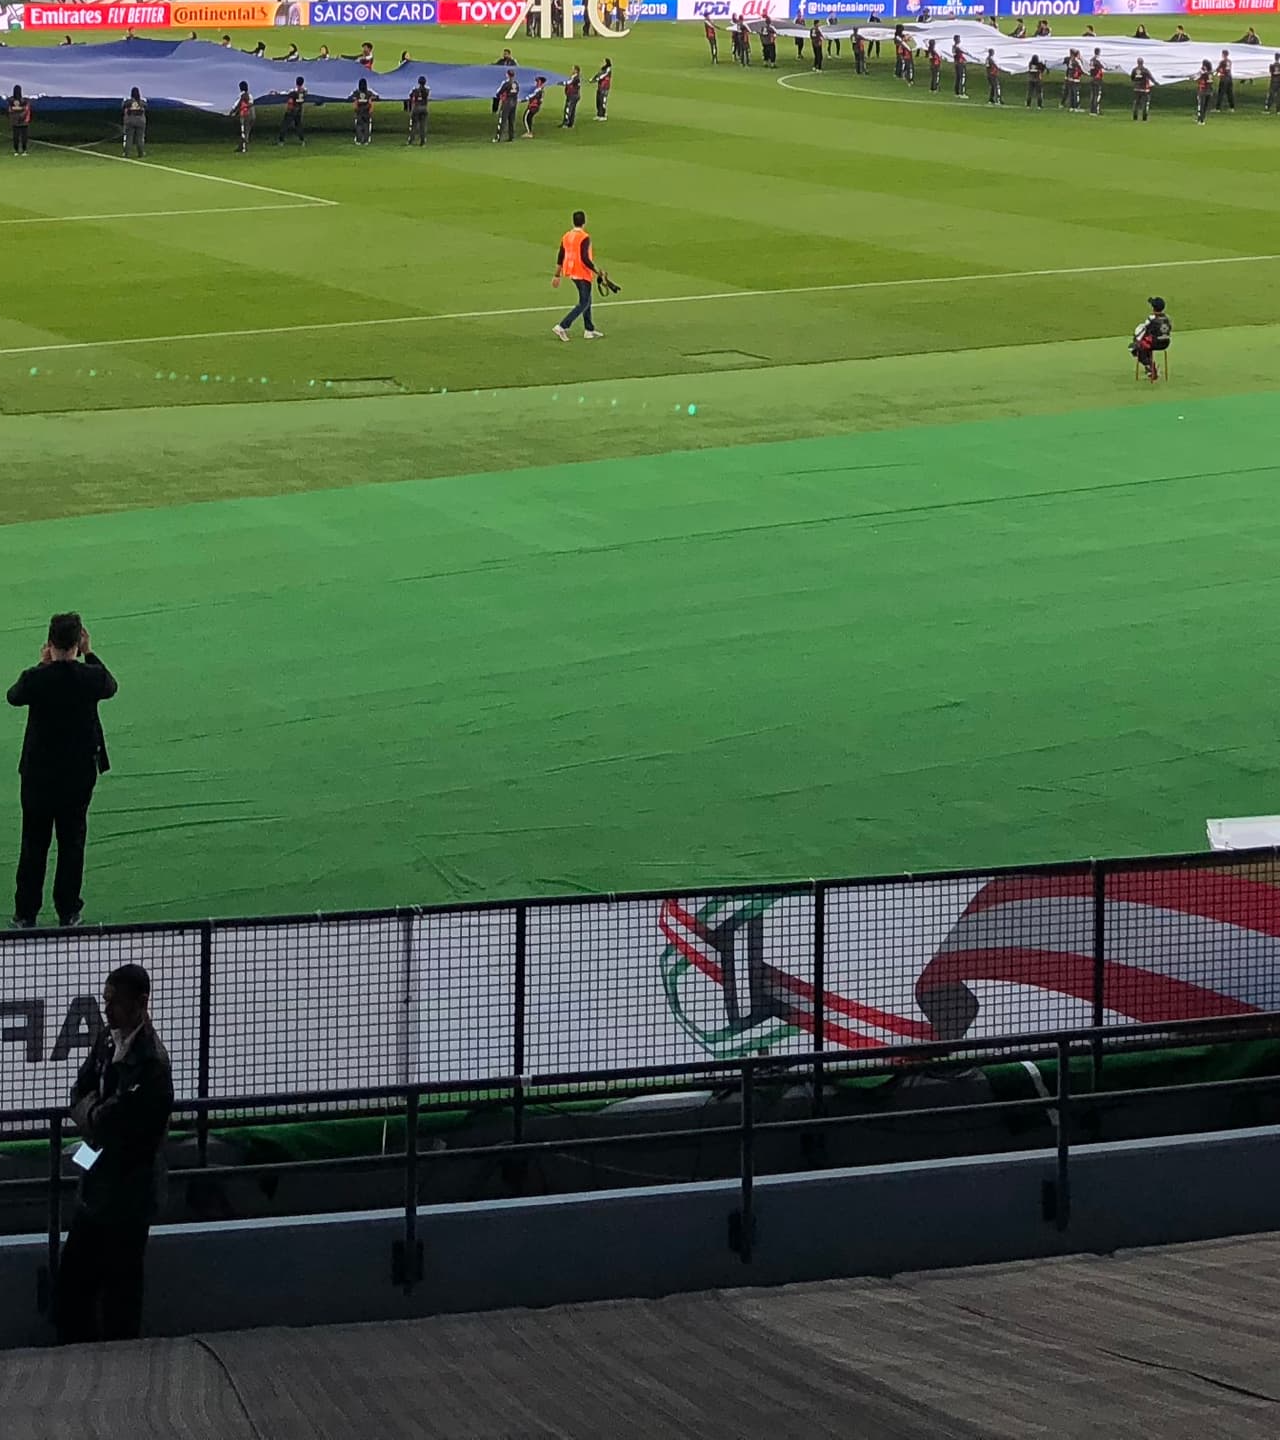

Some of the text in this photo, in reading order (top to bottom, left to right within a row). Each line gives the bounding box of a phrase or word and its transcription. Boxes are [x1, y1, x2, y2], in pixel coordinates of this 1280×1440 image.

[31, 7, 165, 25] Emirates FLY BETTER
[174, 6, 256, 24] Continental
[313, 1, 435, 22] SAISON CARD
[458, 2, 528, 21] TOYOT
[694, 1, 731, 16] KDDI
